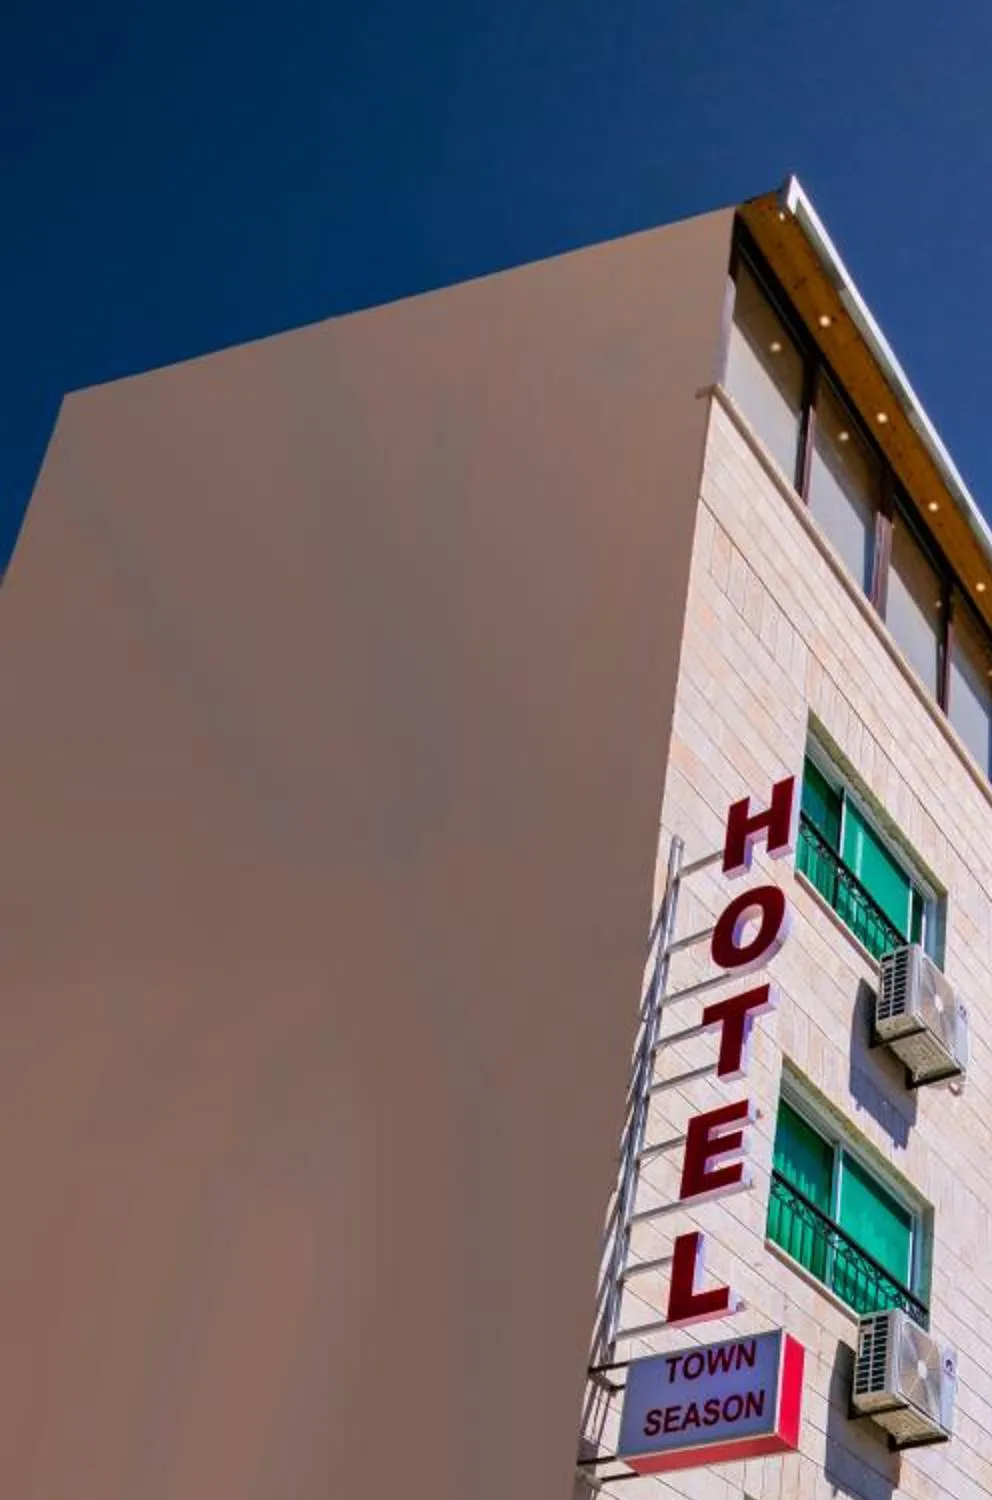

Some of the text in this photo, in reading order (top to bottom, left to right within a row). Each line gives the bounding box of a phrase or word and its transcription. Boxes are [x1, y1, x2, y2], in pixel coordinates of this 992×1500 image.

[666, 775, 797, 1325] HOTEL
[666, 1340, 756, 1384] TOWN
[643, 1389, 766, 1437] SEASON
